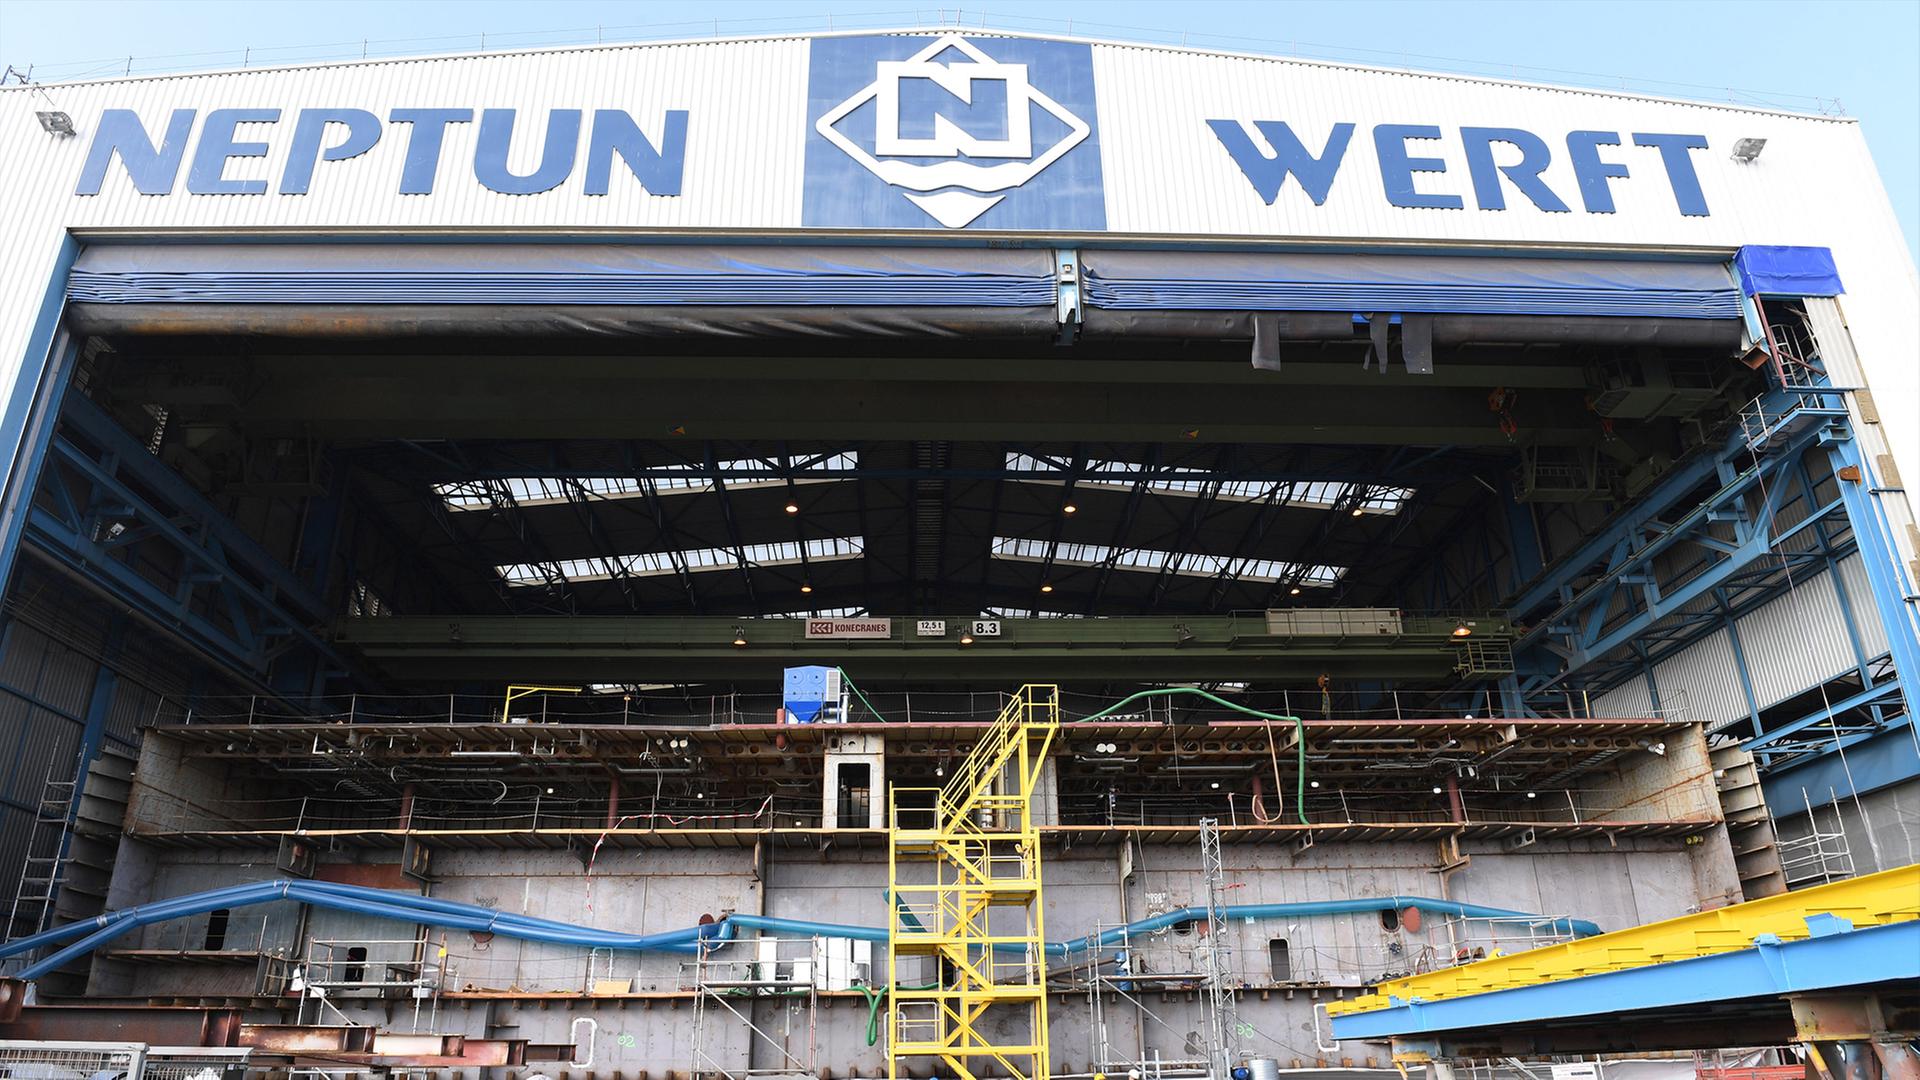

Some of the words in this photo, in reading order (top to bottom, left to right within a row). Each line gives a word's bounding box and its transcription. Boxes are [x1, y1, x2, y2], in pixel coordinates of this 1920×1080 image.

[75, 108, 690, 197] NEPTUN
[1205, 119, 1710, 217] WERFT
[835, 624, 886, 632] KONECRANES
[976, 622, 997, 634] 8.3
